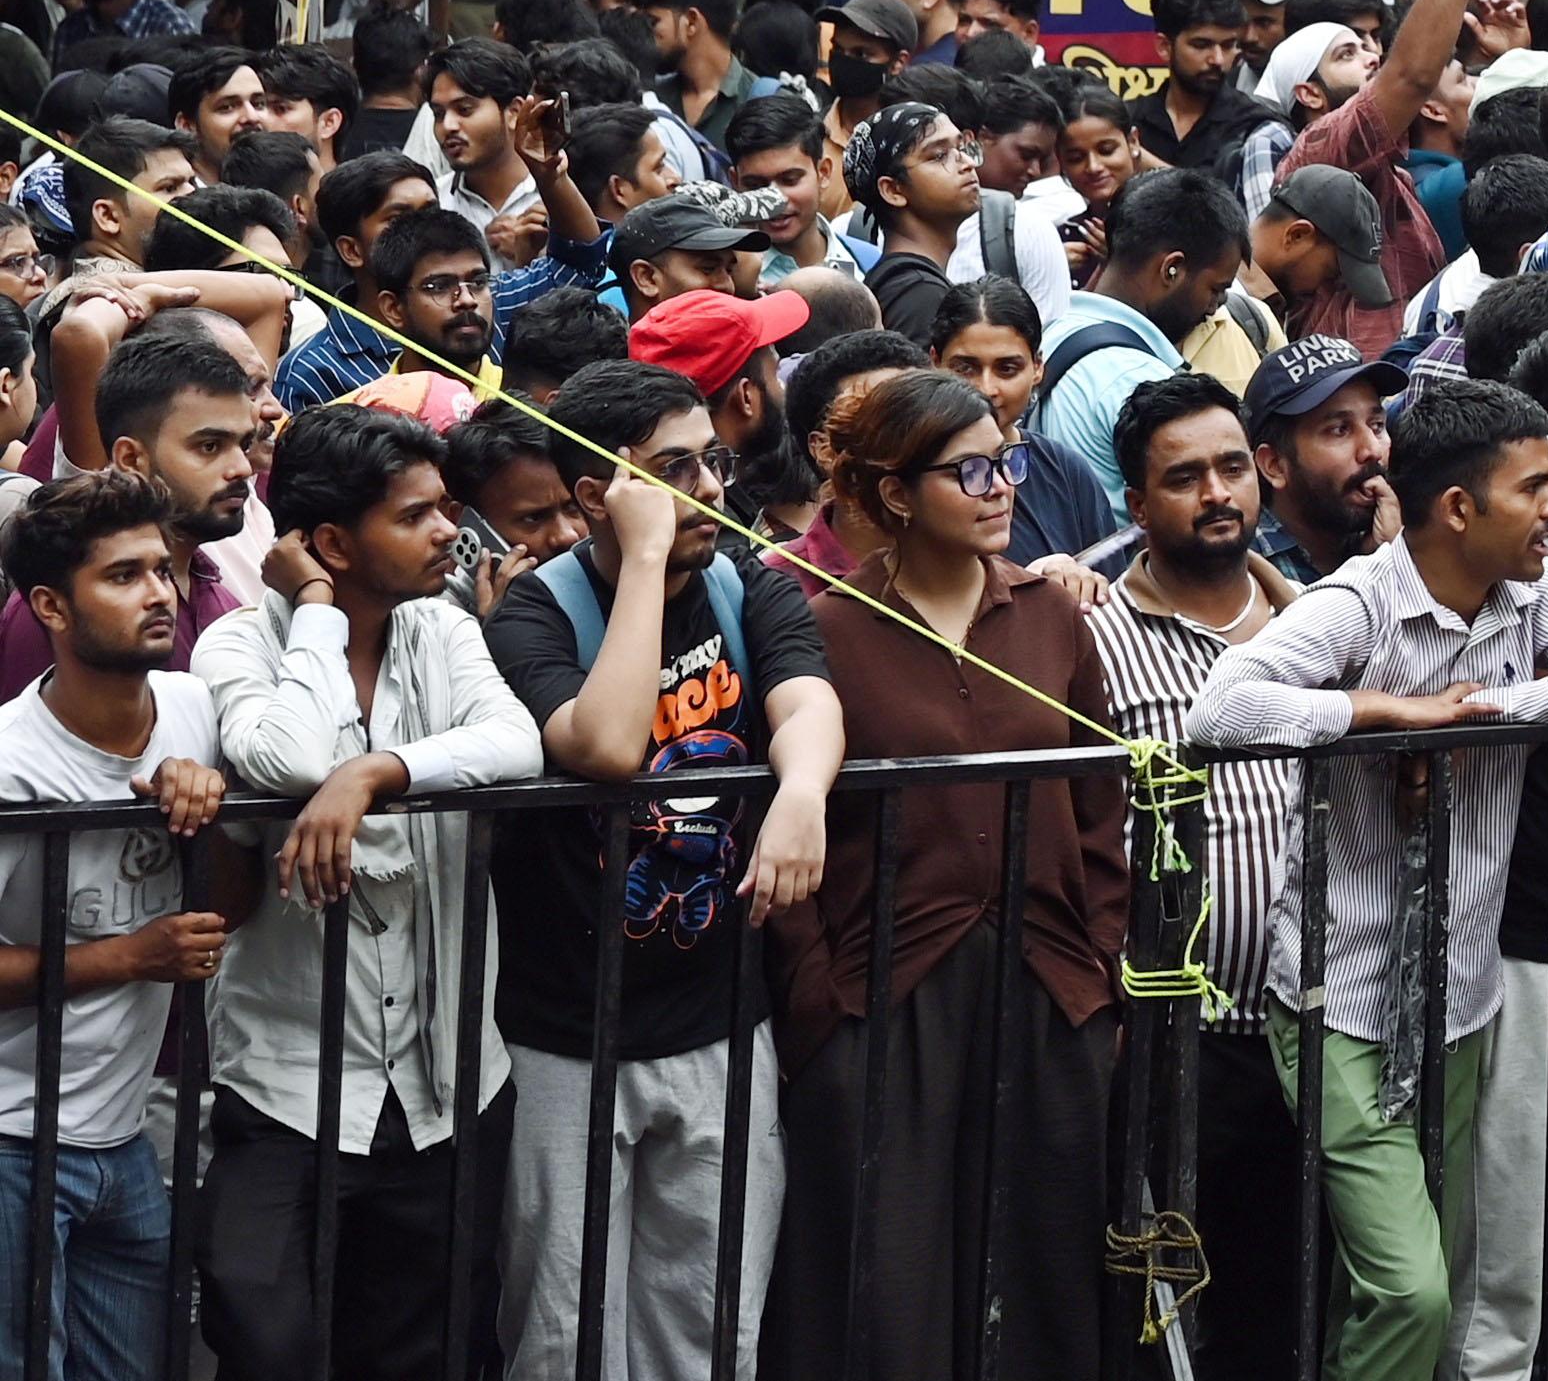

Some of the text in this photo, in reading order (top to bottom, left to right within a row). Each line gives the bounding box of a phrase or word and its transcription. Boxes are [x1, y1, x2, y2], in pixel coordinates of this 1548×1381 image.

[1287, 348, 1359, 384] PARK
[680, 633, 723, 679] my
[652, 659, 743, 748] ace
